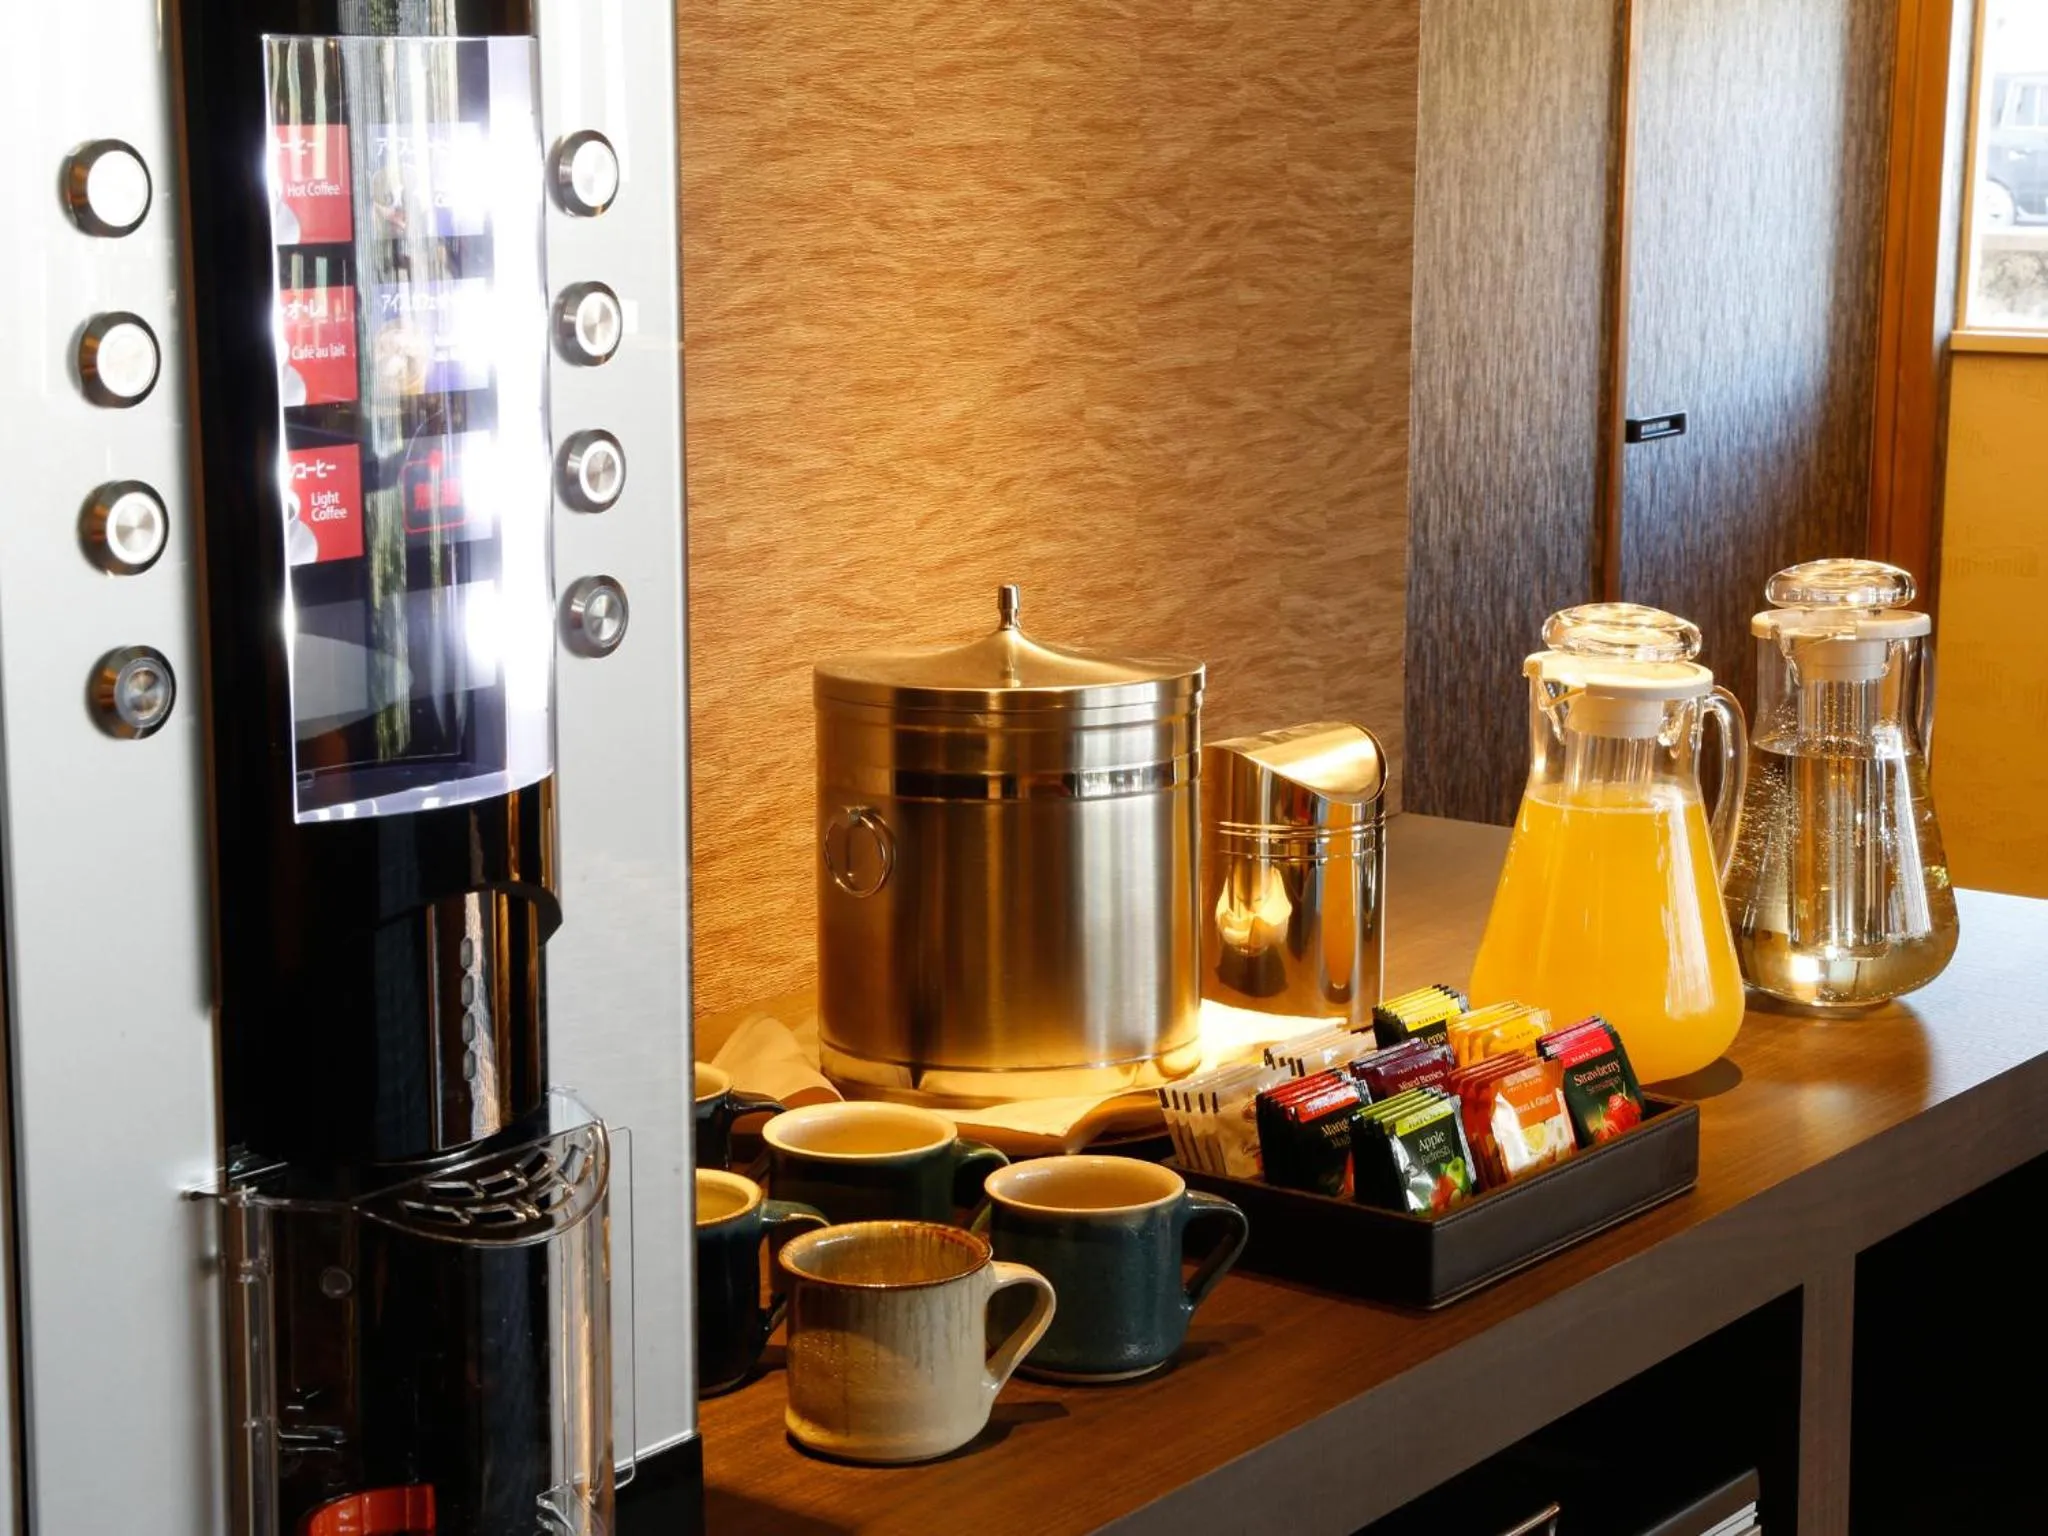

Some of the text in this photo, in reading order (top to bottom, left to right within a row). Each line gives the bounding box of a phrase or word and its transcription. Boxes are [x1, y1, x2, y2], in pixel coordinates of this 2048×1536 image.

[287, 180, 341, 197] Hot Coffee
[315, 347, 328, 359] au
[311, 490, 340, 508] Light
[311, 506, 348, 522] Coffee
[1421, 1031, 1447, 1049] Lemo
[1419, 1070, 1445, 1084] Berries
[1573, 1060, 1620, 1087] Strawberry
[1321, 1117, 1350, 1137] Mang
[1419, 1131, 1445, 1152] Apple
